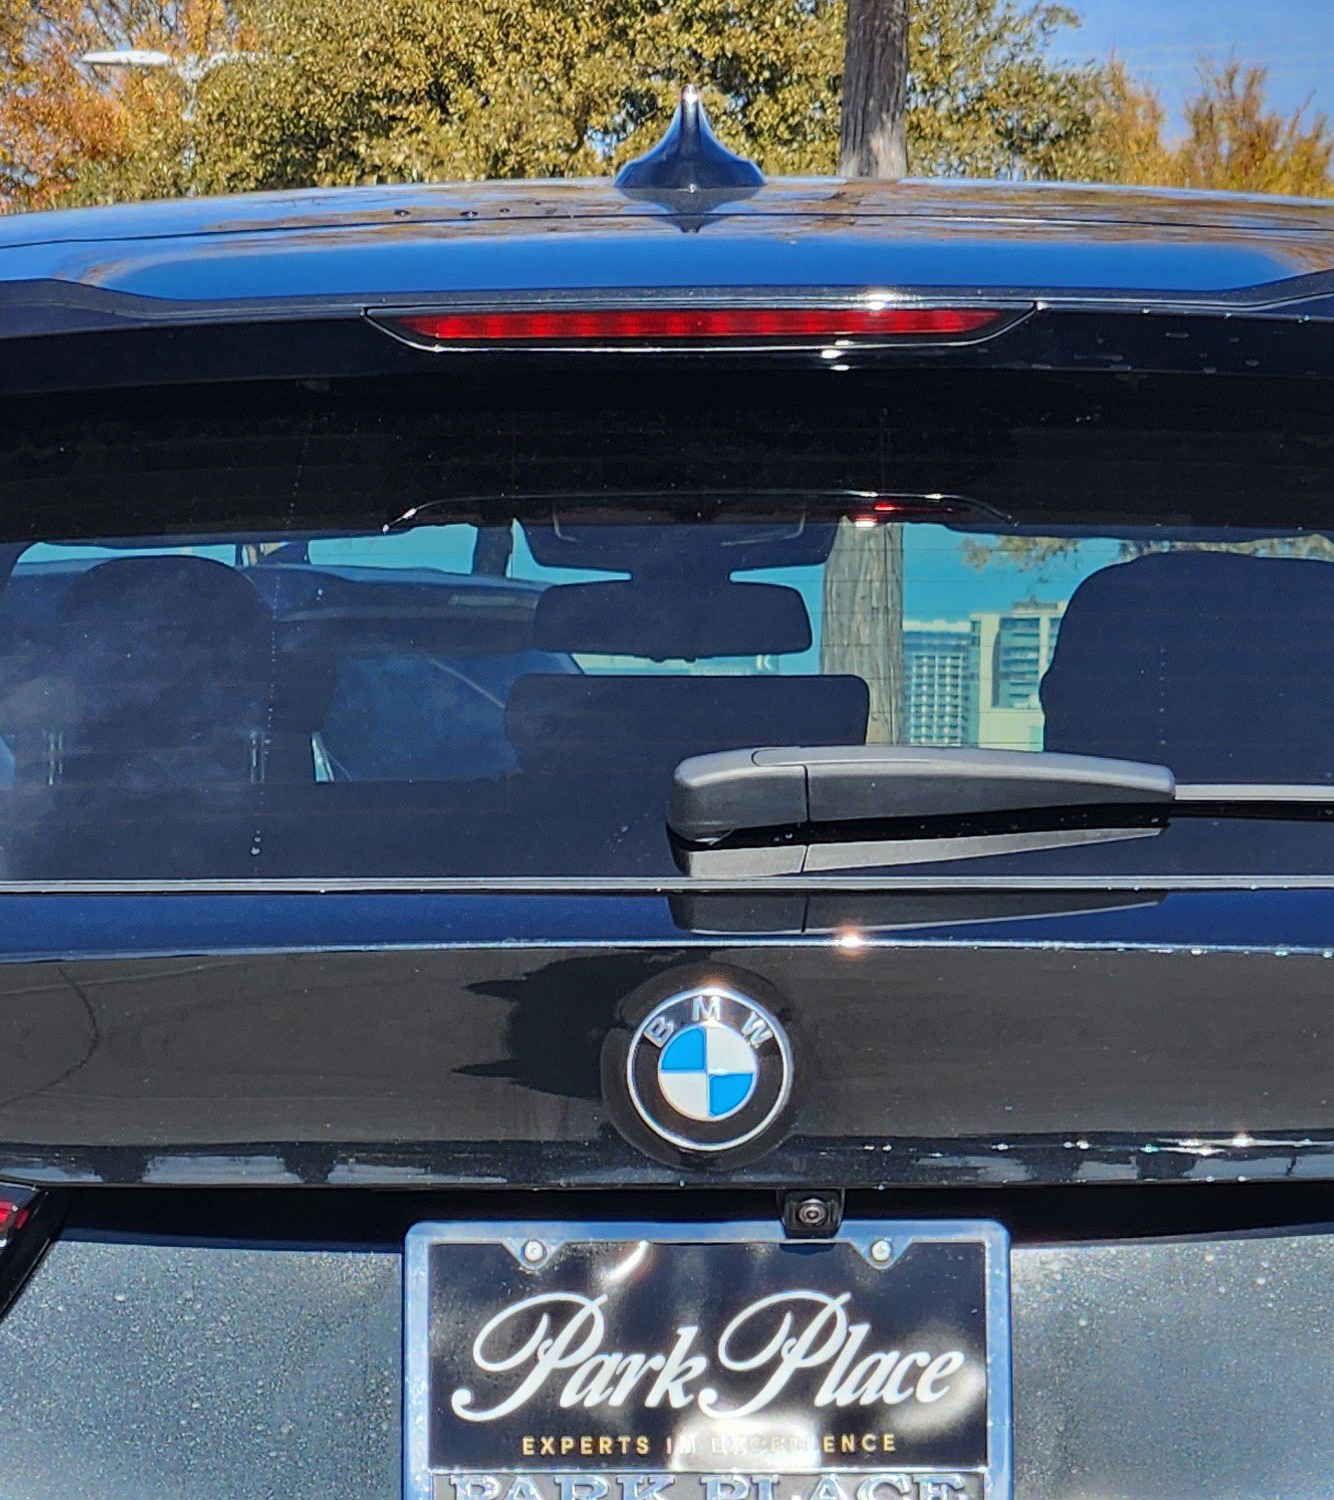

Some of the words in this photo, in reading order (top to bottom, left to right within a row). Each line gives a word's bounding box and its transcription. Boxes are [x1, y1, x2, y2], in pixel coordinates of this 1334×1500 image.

[643, 995, 773, 1049] BMW
[451, 1291, 707, 1421] Park
[698, 1290, 967, 1419] Place
[521, 1435, 650, 1456] EXPERTS
